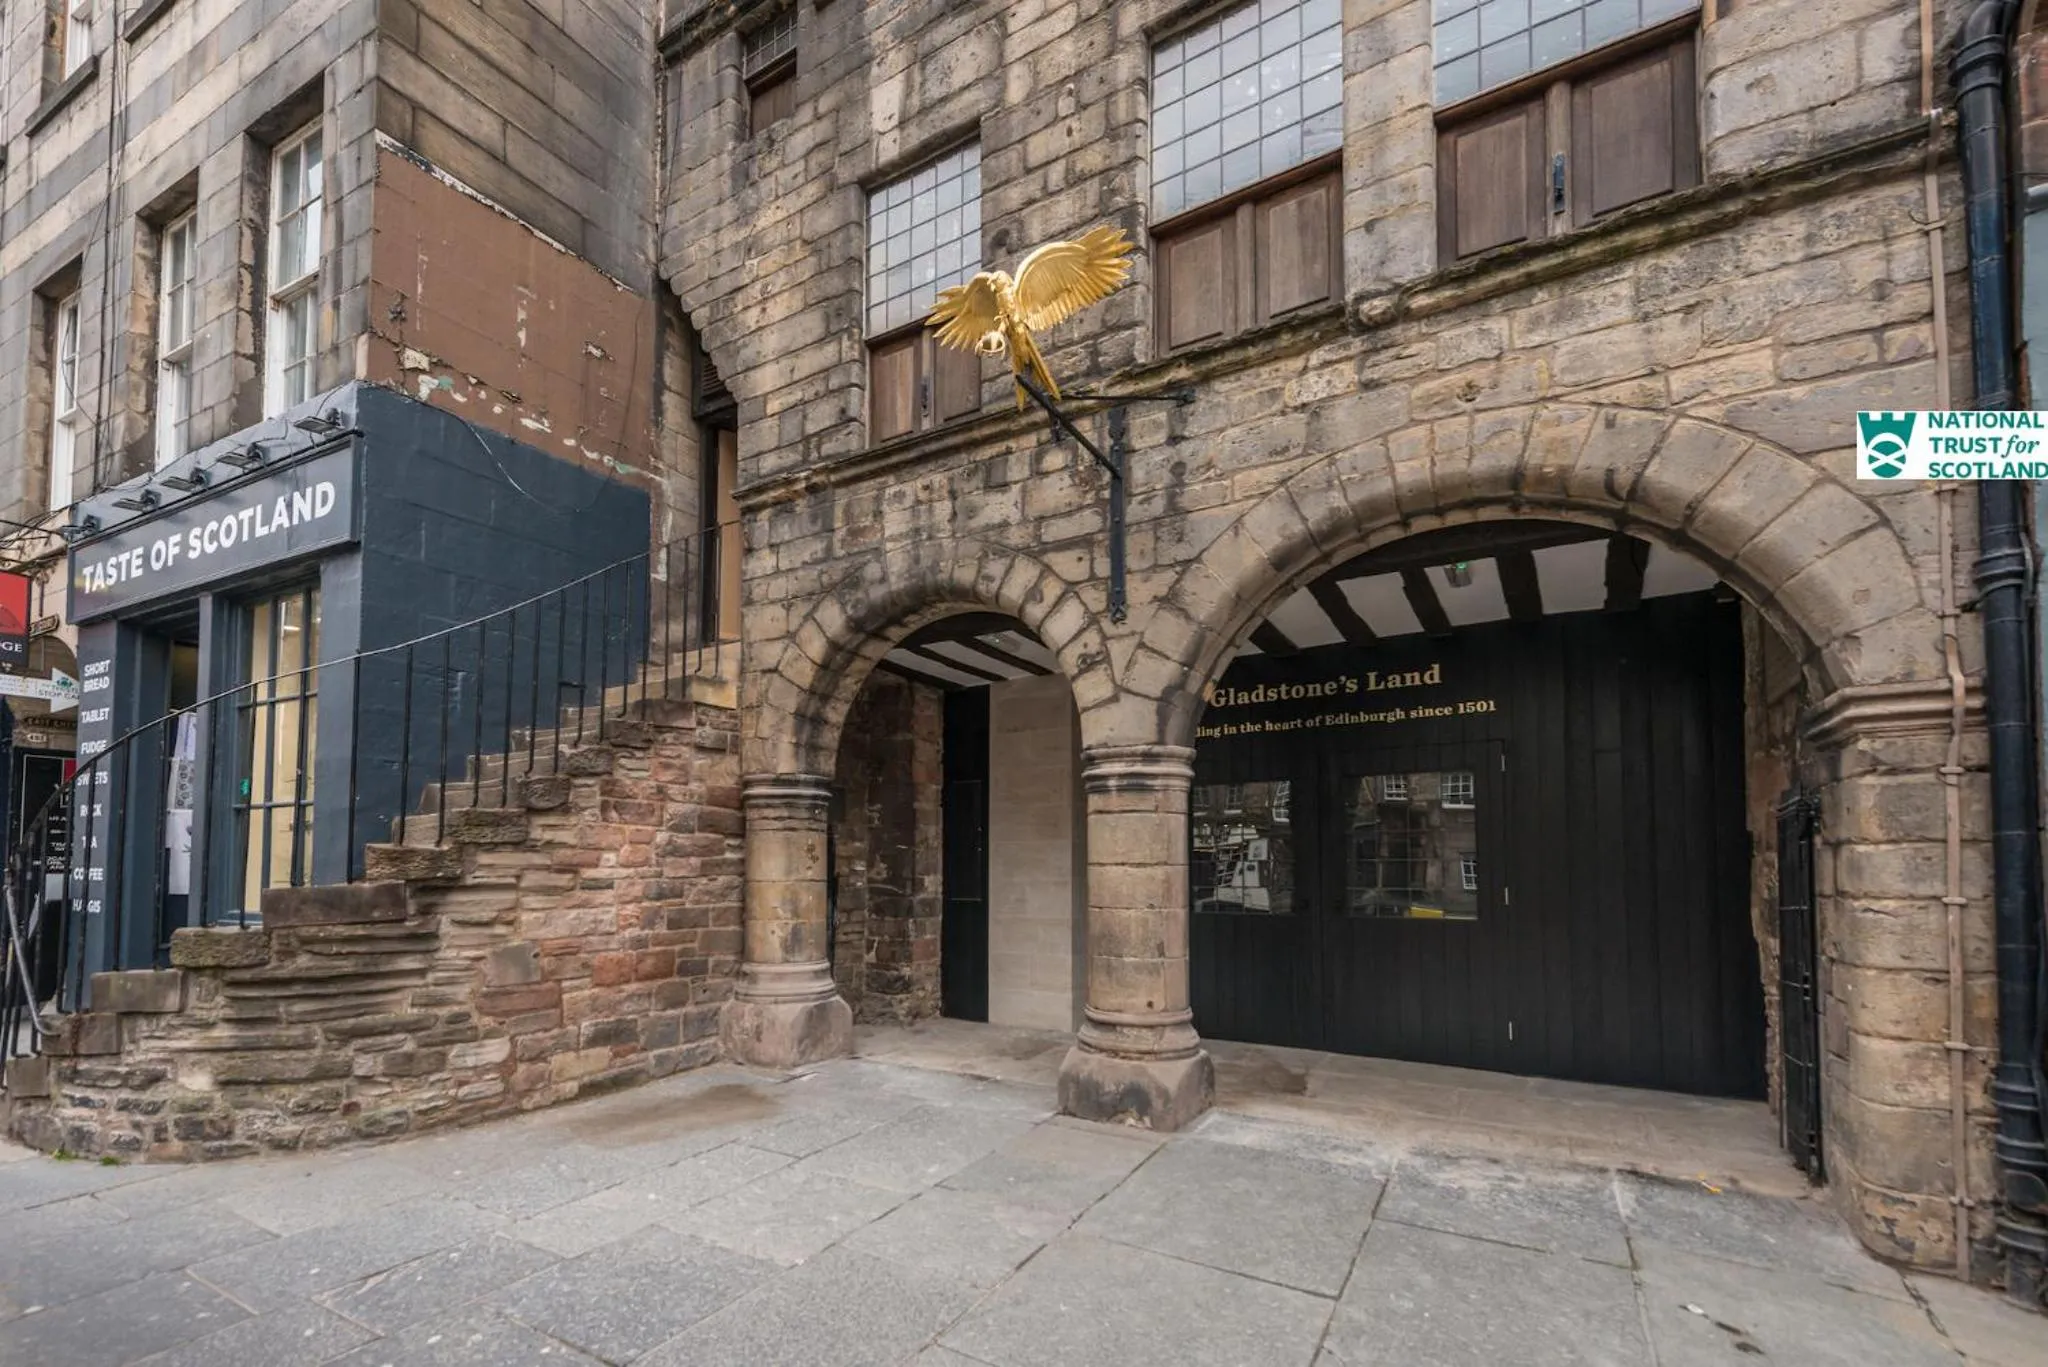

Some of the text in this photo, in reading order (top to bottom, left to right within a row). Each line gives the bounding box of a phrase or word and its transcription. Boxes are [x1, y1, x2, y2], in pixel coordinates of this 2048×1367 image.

[82, 481, 335, 594] TASTE OF SCOTLAND
[84, 660, 111, 677] SHORT
[83, 676, 110, 693] BREAD
[1210, 664, 1442, 707] Gladstone's Land
[81, 707, 110, 723] TABLET
[1223, 723, 1237, 735] in
[1240, 721, 1262, 733] the
[1265, 719, 1302, 731] heart
[1305, 715, 1323, 728] of
[1325, 707, 1406, 726] Edinburgh
[1409, 705, 1453, 719] since
[1457, 700, 1496, 714] 1501
[80, 740, 107, 755] FUDGE
[77, 771, 108, 786] SWETS
[81, 836, 98, 849] TA
[73, 868, 104, 881] COFEE
